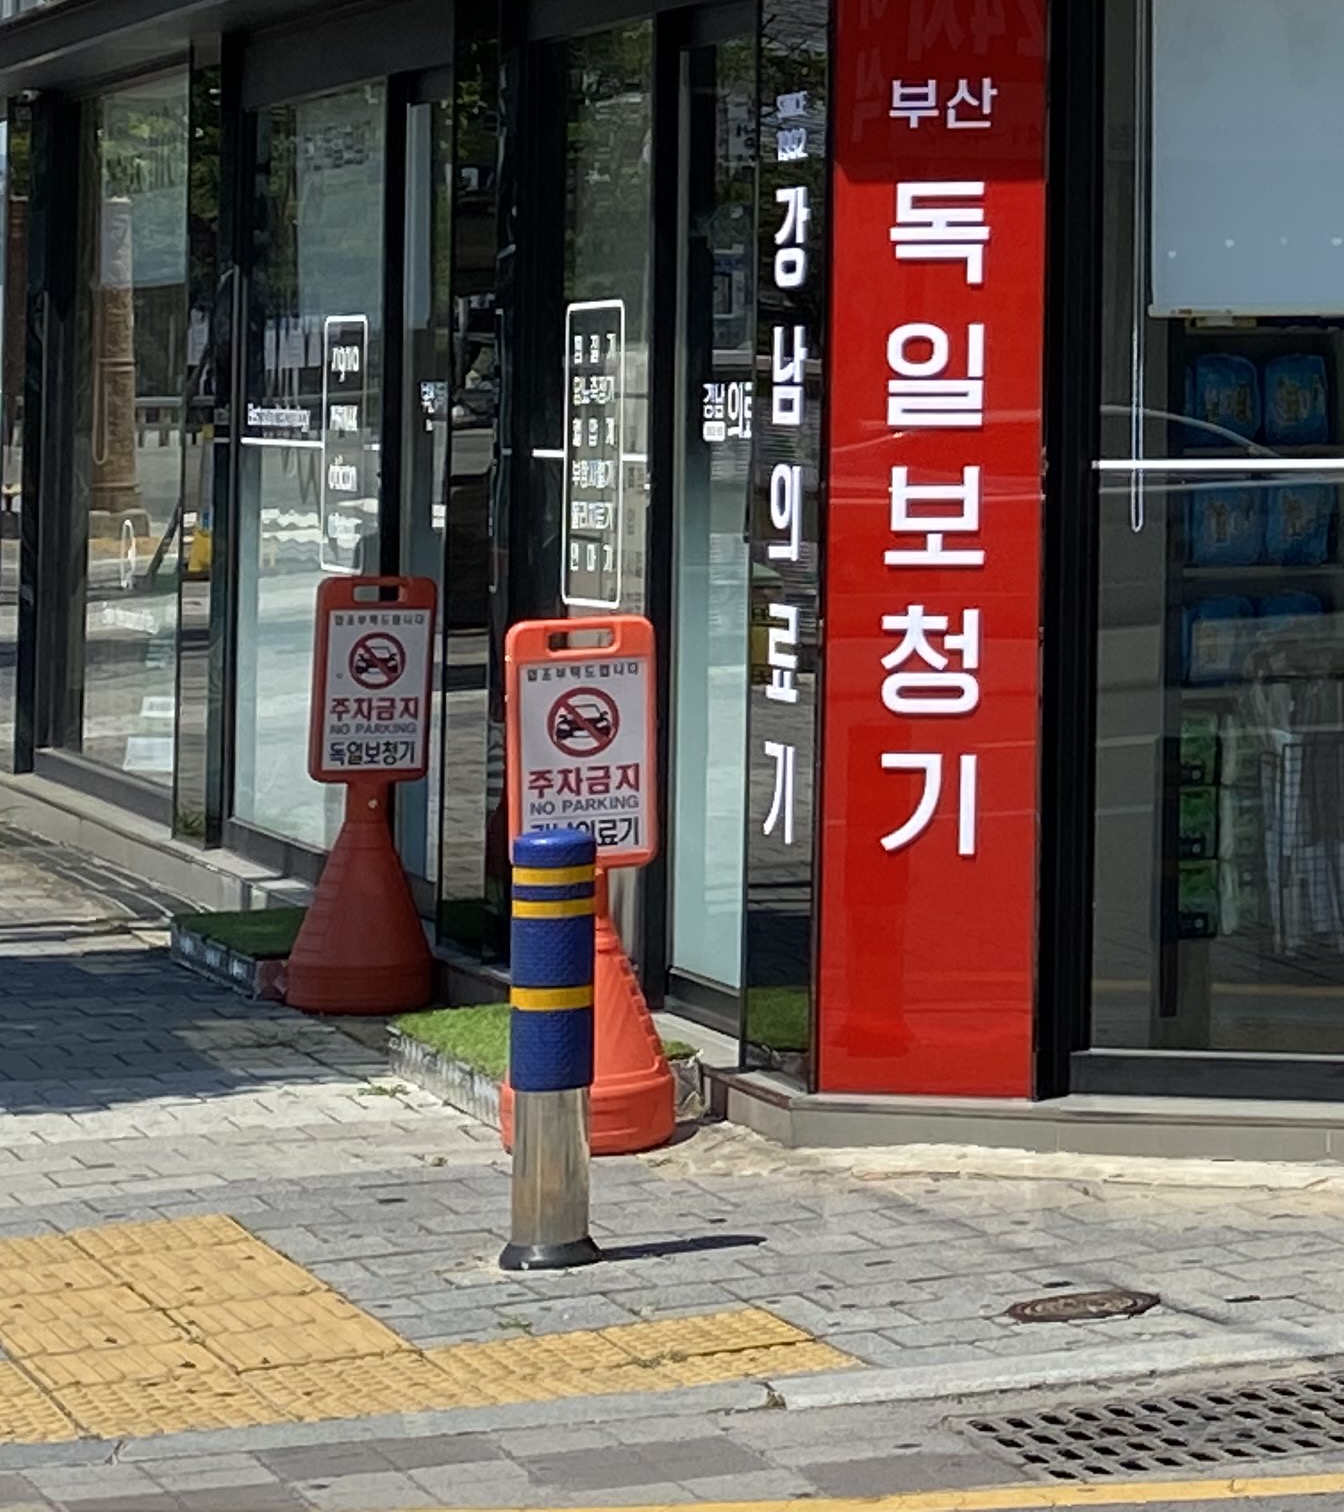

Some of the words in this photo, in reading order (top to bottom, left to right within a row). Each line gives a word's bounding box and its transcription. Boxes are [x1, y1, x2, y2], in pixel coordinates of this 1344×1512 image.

[888, 76, 998, 130] 부산
[763, 185, 811, 845] 강남의료기
[878, 180, 991, 857] 독일보청기
[329, 696, 419, 723] 주차금지
[329, 723, 351, 736] NO
[354, 722, 417, 735] PARKING
[328, 740, 416, 767] 독일보청기
[527, 762, 641, 799] 주차금지
[529, 799, 556, 816] NO
[561, 794, 640, 815] PARKING
